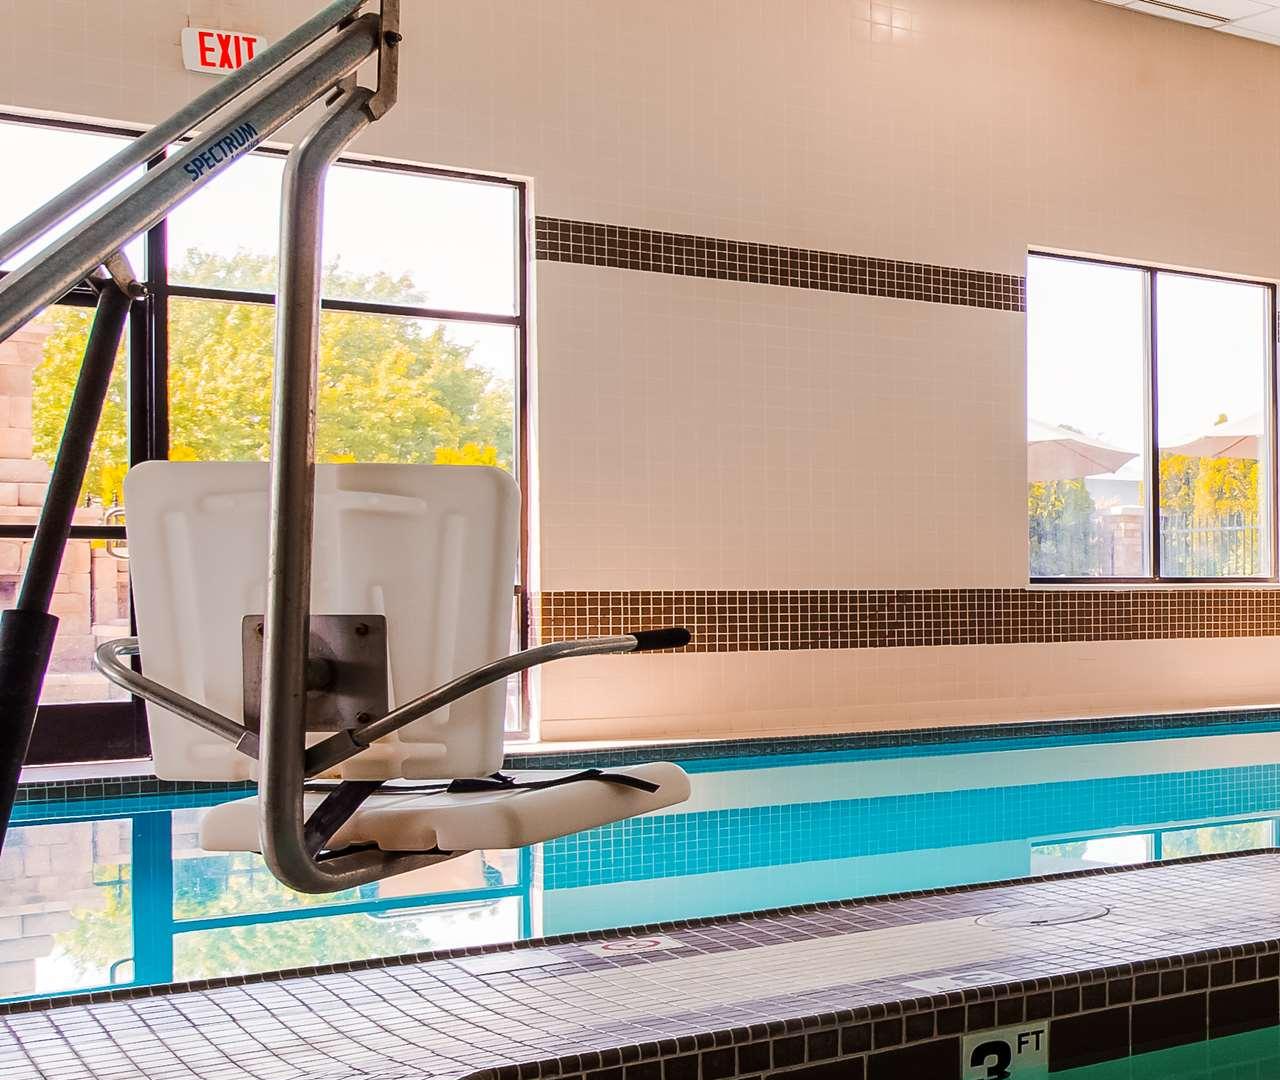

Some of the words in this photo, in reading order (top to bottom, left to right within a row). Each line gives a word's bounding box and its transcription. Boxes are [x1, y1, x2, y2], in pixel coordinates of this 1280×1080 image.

[198, 31, 257, 69] EXIT
[183, 122, 258, 182] SPECTRUM
[1017, 1029, 1044, 1055] FT
